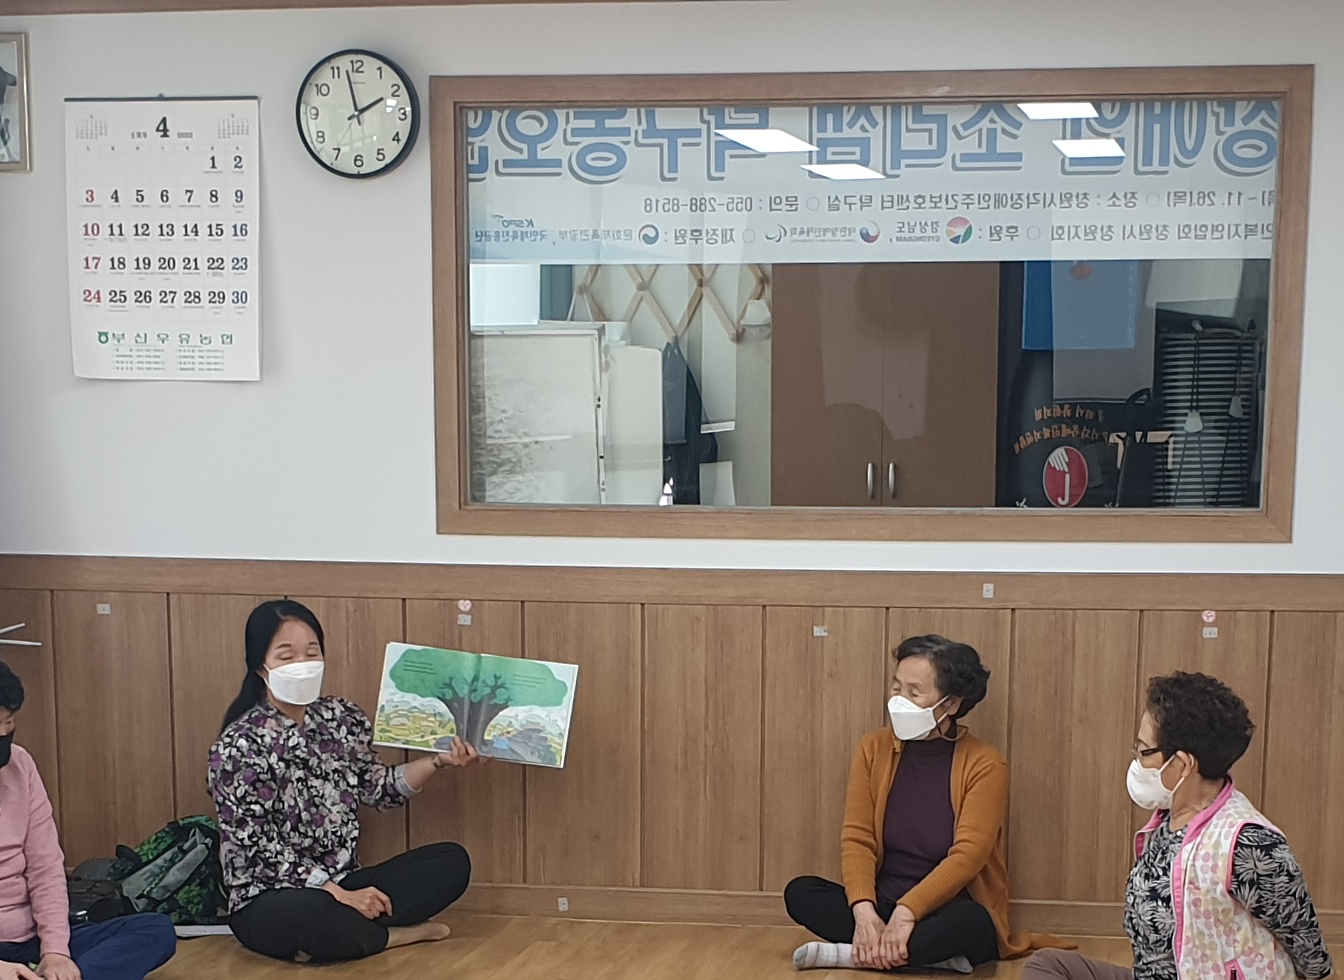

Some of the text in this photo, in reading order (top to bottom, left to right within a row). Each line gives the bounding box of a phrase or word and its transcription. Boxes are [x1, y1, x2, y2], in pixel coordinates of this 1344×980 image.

[330, 66, 340, 79] 11
[350, 60, 364, 73] 12
[376, 67, 382, 79] 1
[315, 83, 330, 96] 10
[391, 84, 400, 97] 2
[309, 107, 319, 120] 9
[398, 108, 407, 121] 3
[155, 117, 170, 138] 4
[316, 131, 325, 144] 8
[392, 131, 401, 144] 4
[333, 148, 341, 161] 7
[354, 155, 364, 167] 6
[376, 148, 385, 161] 5
[210, 155, 243, 169] 1 2
[86, 189, 243, 203] 3 4 5 6 7 8 9
[83, 223, 248, 237] 10 11 12 13 14 15 16
[84, 256, 248, 270] 17 18 19 20 21 22 23
[83, 289, 248, 304] 24 25 26 27 28 29 30
